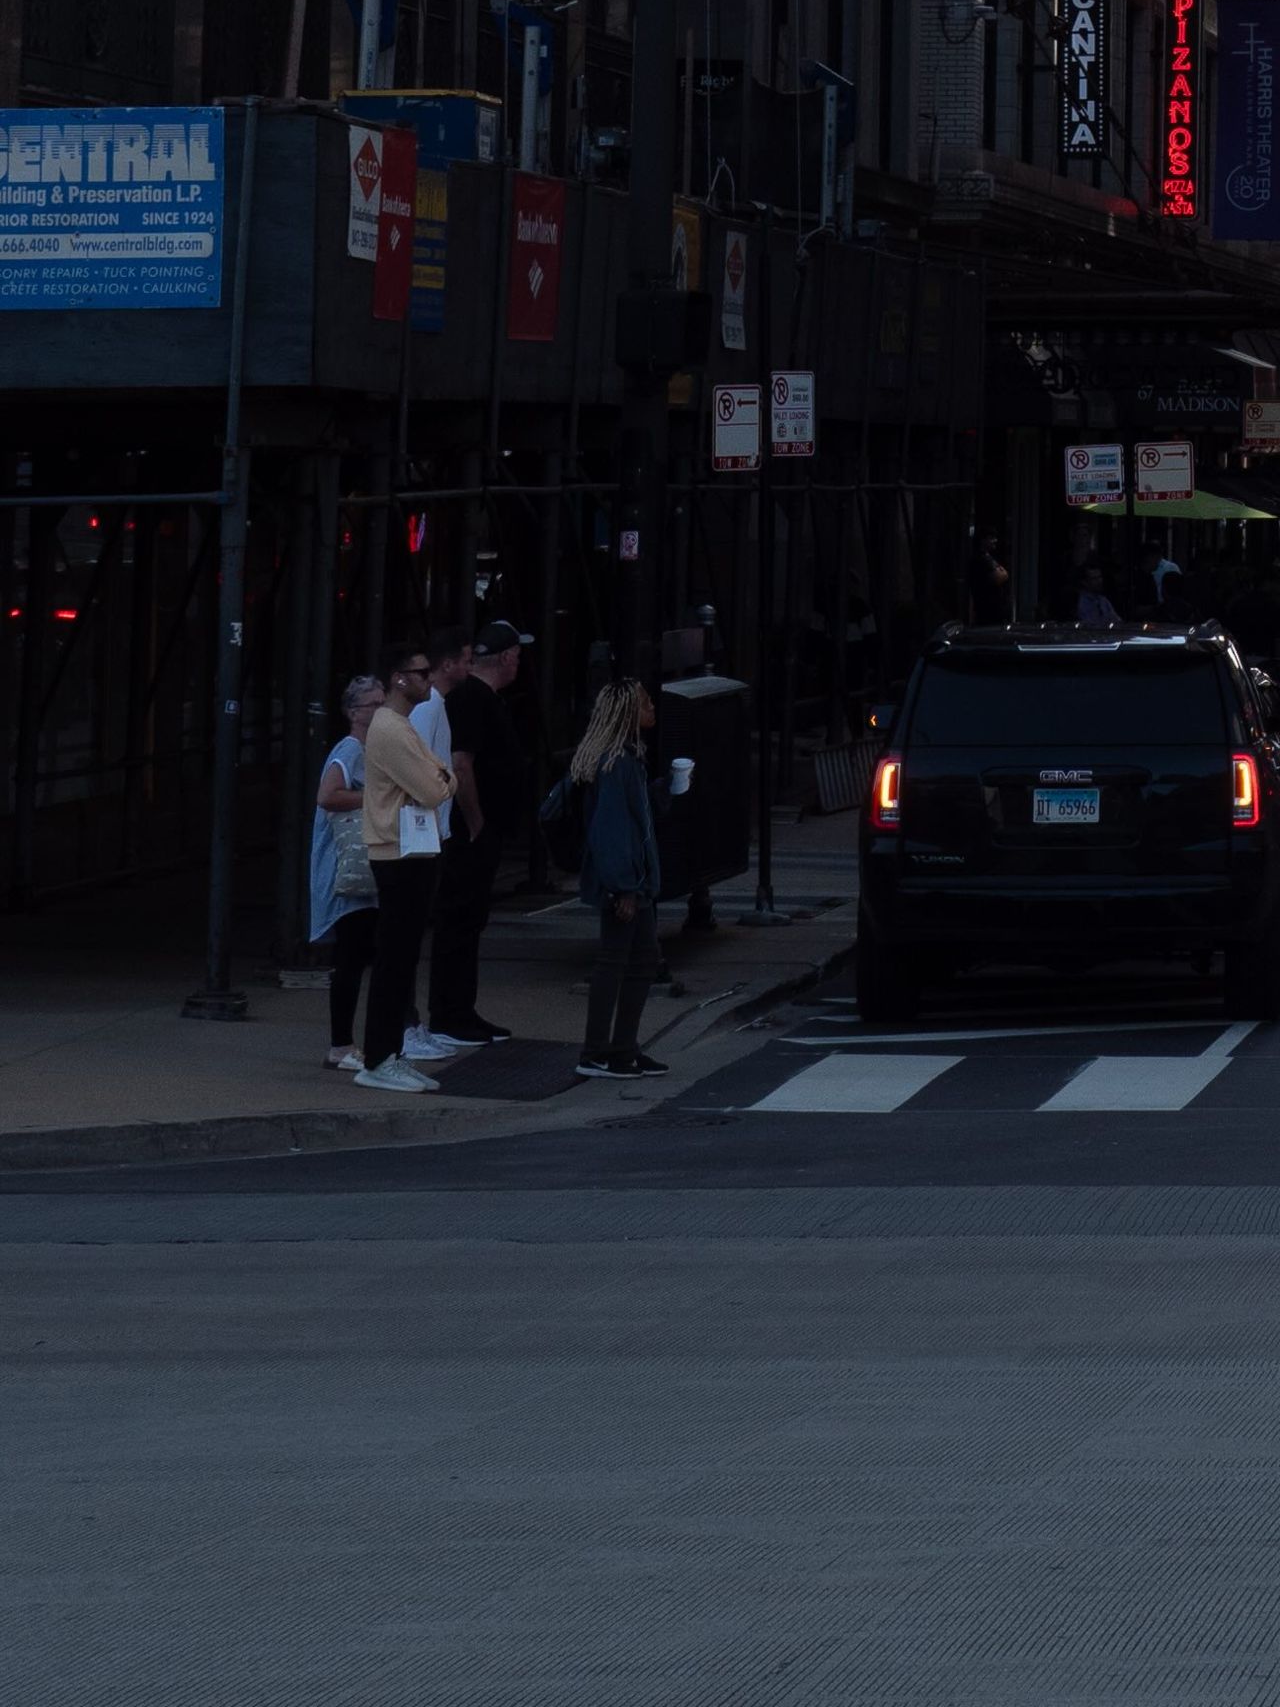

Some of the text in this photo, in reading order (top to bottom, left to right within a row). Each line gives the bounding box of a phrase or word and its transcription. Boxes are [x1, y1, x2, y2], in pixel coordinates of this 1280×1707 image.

[1254, 47, 1273, 203] HARRIS THEATER
[51, 185, 64, 204] &
[68, 185, 173, 204] Preservation
[176, 183, 202, 203] L.P.
[1163, 179, 1195, 196] PIZZA
[1240, 174, 1255, 200] 20
[31, 212, 120, 227] RESTORATION
[142, 211, 180, 226] SINCE
[184, 211, 214, 225] 1924
[70, 236, 203, 255] www.centralbldg.com
[0, 265, 205, 280] ONRY REPAIRS TUCK POINTING
[42, 282, 129, 295] RESTORATION
[142, 281, 208, 294] CAULKING
[1156, 396, 1241, 412] MADISON
[773, 442, 811, 453] TOW ZONE
[1071, 493, 1120, 504] TOW ZONE
[1040, 770, 1093, 783] GMC
[1058, 798, 1096, 816] 65966
